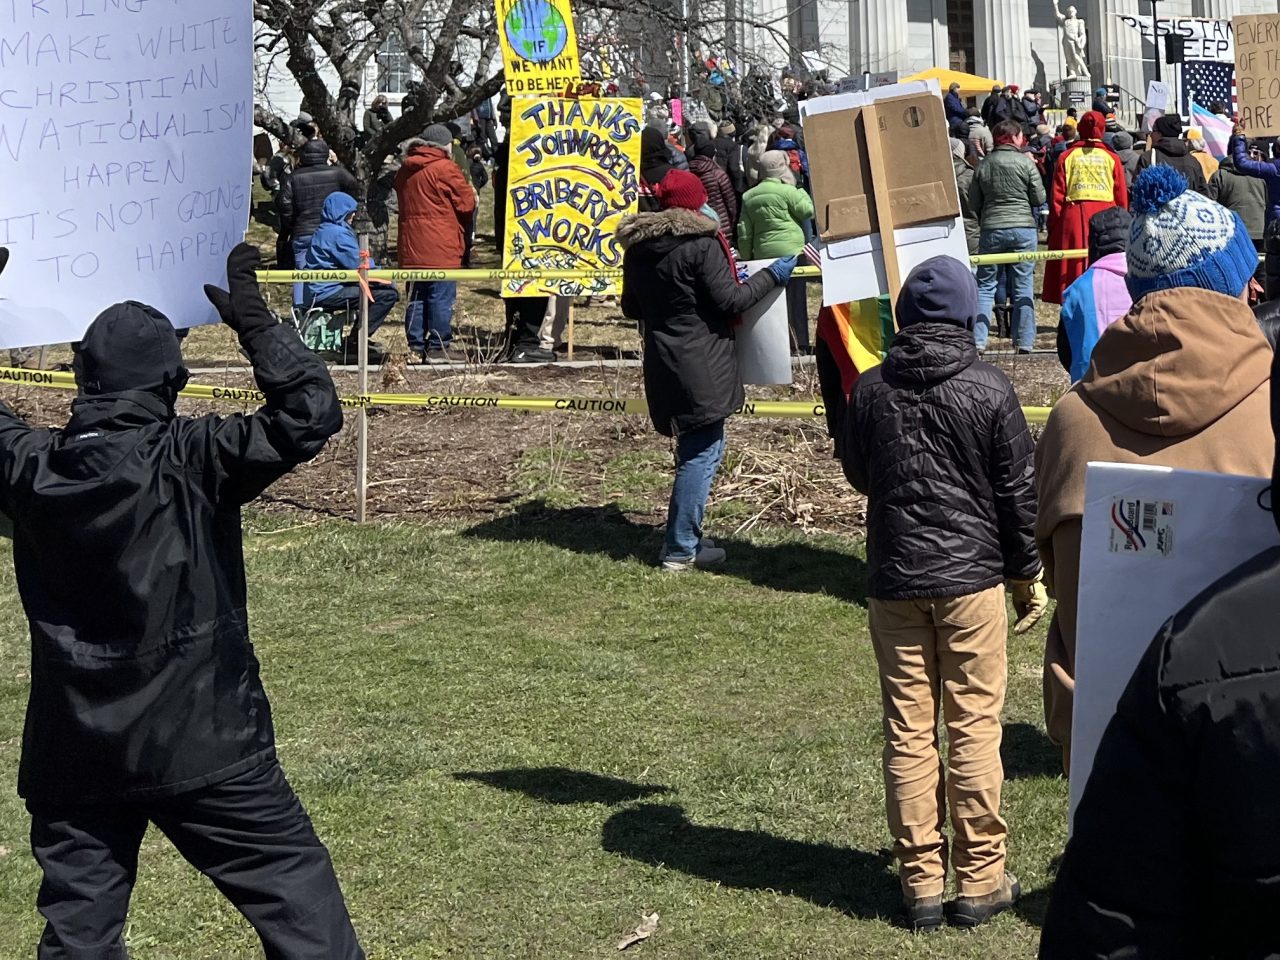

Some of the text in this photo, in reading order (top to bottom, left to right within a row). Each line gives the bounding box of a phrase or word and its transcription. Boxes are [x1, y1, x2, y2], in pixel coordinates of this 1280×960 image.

[1, 16, 237, 68] MAKE WHITE
[533, 40, 546, 53] IF
[1184, 39, 1229, 58] EEP
[1240, 51, 1257, 71] OF
[0, 60, 219, 108] CHRISTIAN
[511, 58, 573, 73] WE WANT
[507, 79, 524, 92] TO
[527, 78, 544, 91] BE
[2, 100, 246, 161] NATIONALISM
[521, 100, 641, 142] THANKS
[1242, 104, 1273, 129] ARE
[516, 129, 589, 167] JOHN
[63, 151, 185, 193] HAPPEN
[0, 185, 244, 244] IT'S NOT GOING
[510, 176, 621, 227] BRIBERY
[37, 216, 236, 283] TO HAPPEN
[518, 213, 623, 267] WORKS
[0, 369, 53, 384] AUTION
[212, 388, 266, 401] CAUTIO
[427, 396, 627, 412] CAUTION CAUTION
